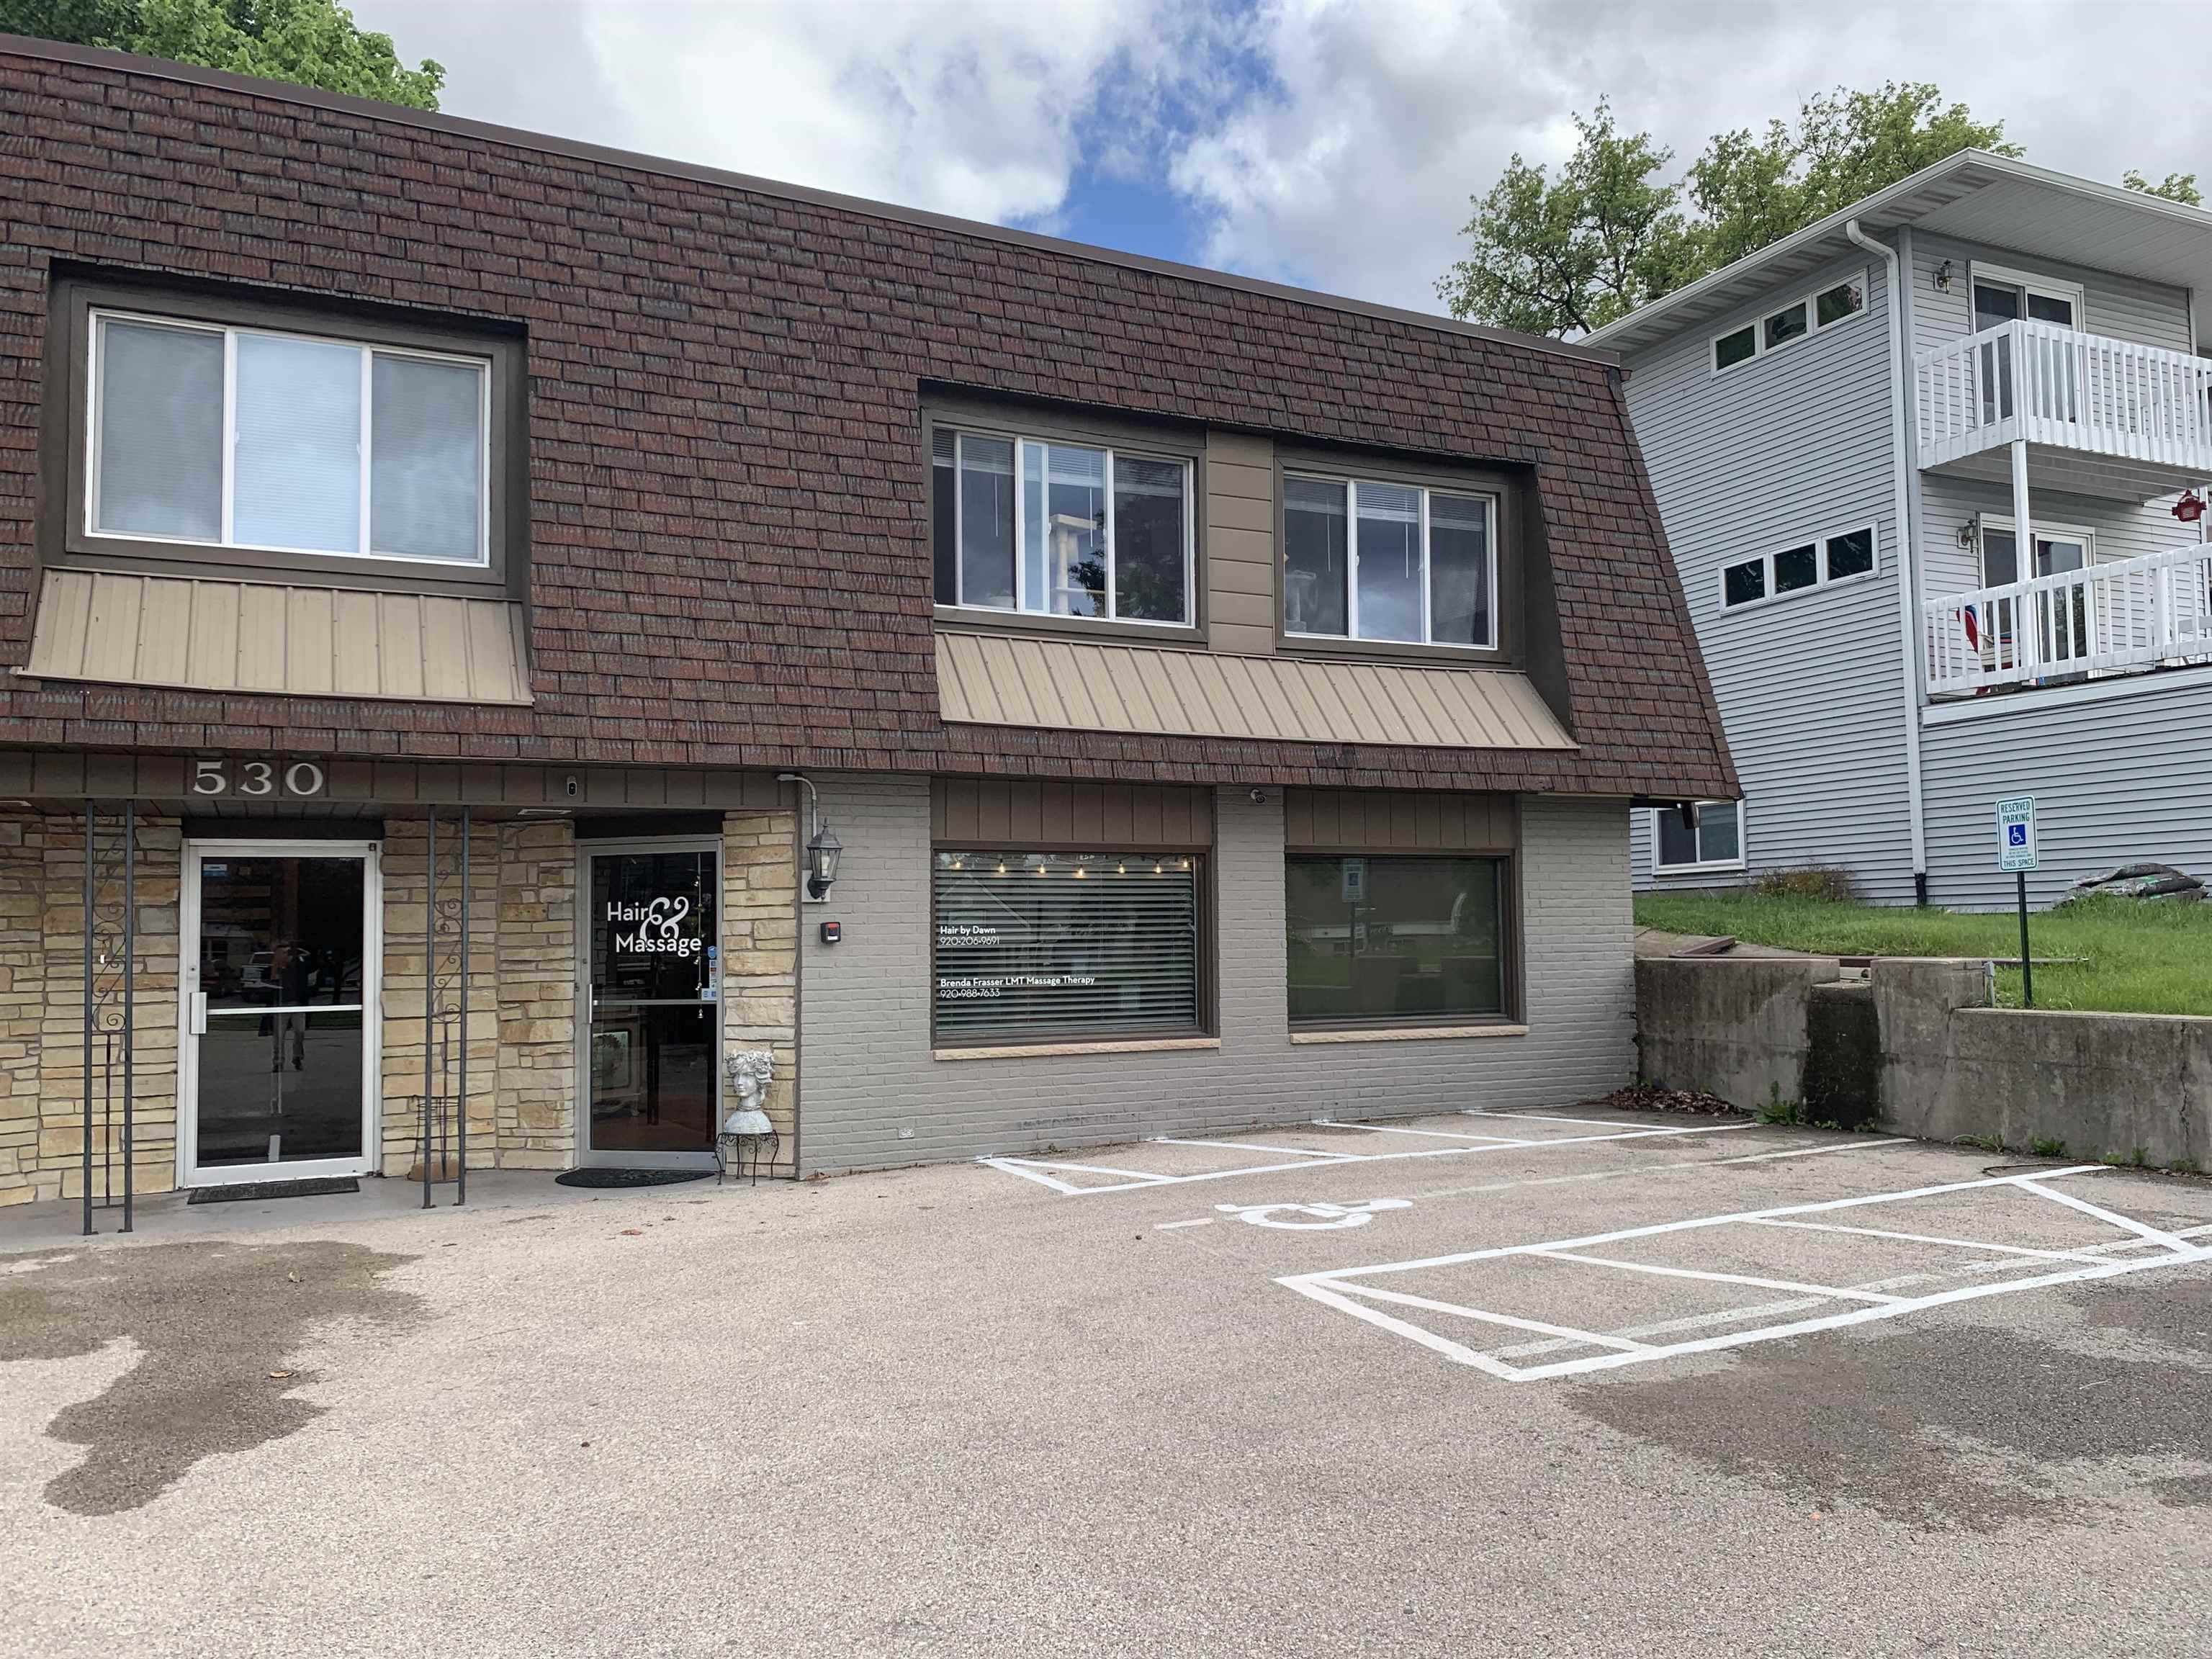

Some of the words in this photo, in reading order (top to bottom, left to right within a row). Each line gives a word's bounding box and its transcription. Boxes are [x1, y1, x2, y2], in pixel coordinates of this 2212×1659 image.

[192, 760, 323, 795] 530
[2001, 801, 2030, 813] RESERVED
[2002, 812, 2030, 824] PARKING
[607, 902, 648, 921] Hair
[639, 896, 689, 940] &
[940, 925, 958, 935] Hair
[960, 925, 971, 936] by
[973, 925, 996, 934] Dawn
[616, 933, 702, 957] Massage
[940, 978, 971, 987] Brenda
[973, 977, 1004, 986] Frasser
[1005, 976, 1025, 986] LMT
[1026, 976, 1061, 986] Massage
[1062, 975, 1095, 985] Therapy
